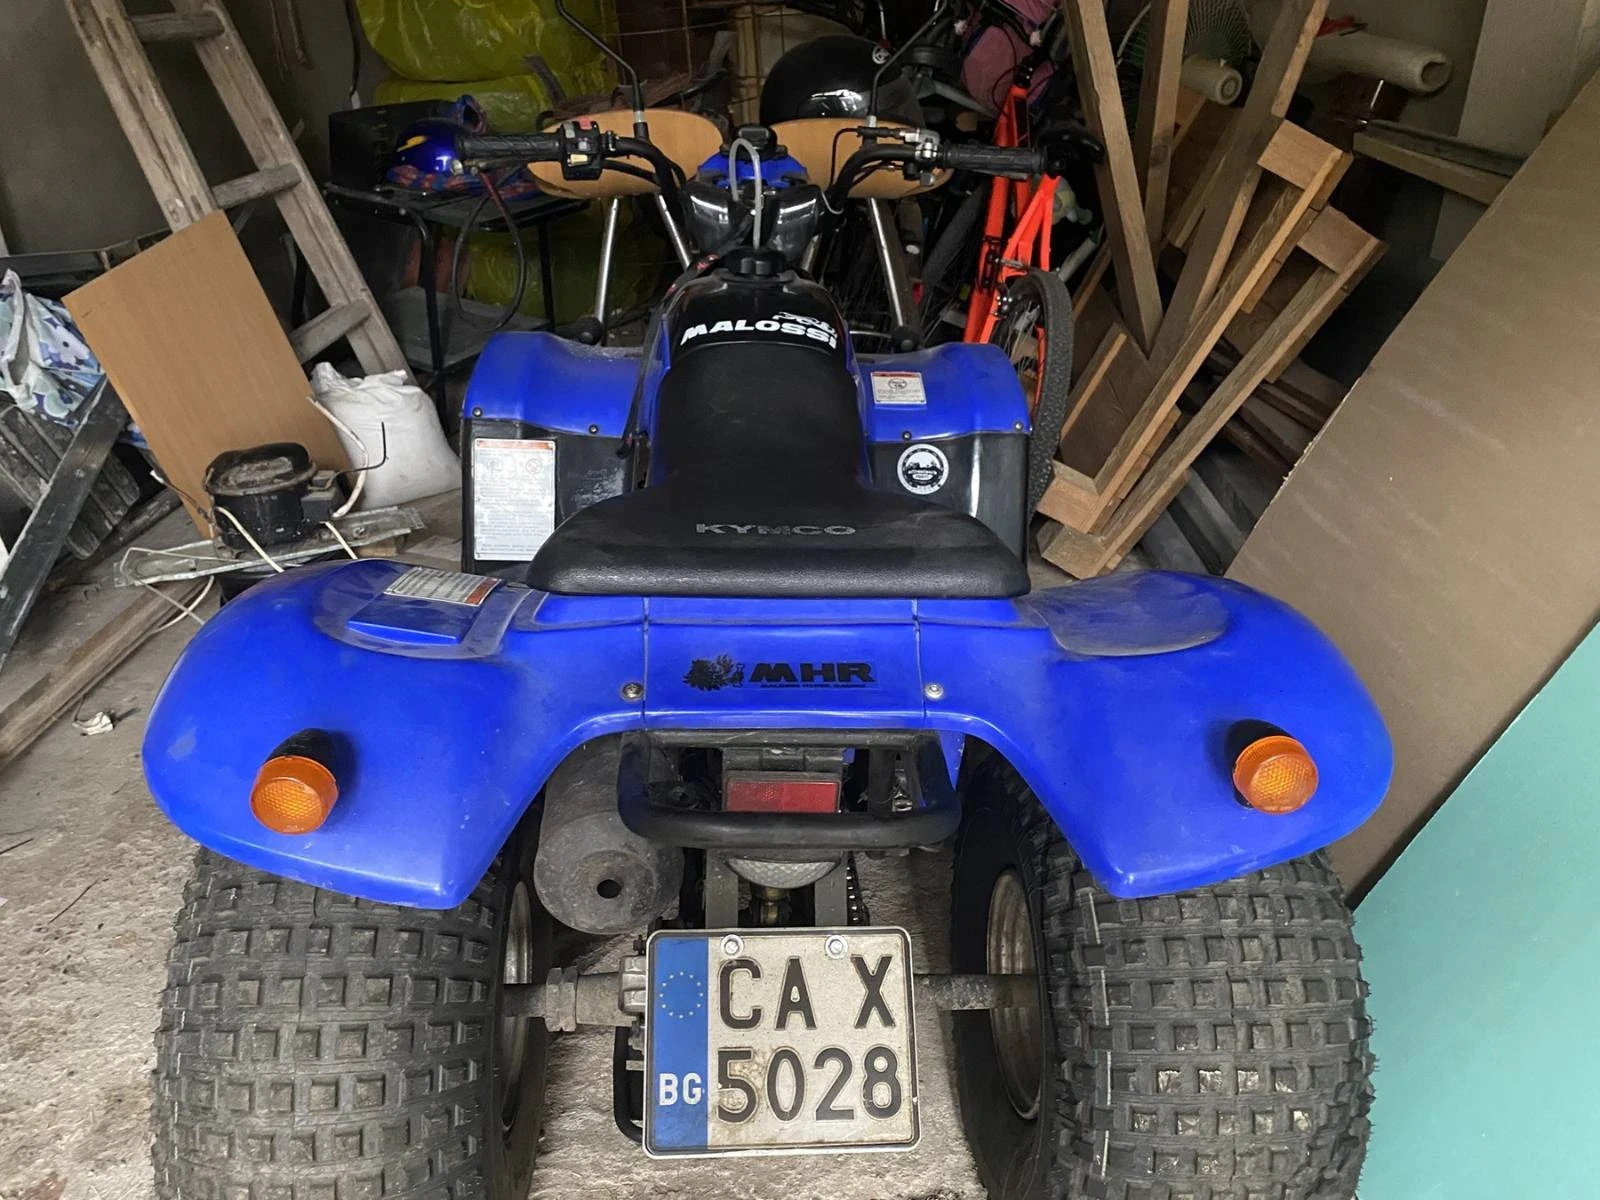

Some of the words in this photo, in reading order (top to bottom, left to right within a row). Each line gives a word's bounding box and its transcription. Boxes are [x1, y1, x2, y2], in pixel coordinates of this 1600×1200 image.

[680, 319, 837, 349] MALOSSI
[748, 662, 875, 683] MHR
[659, 1072, 702, 1106] BG
[717, 1045, 901, 1123] 5028
